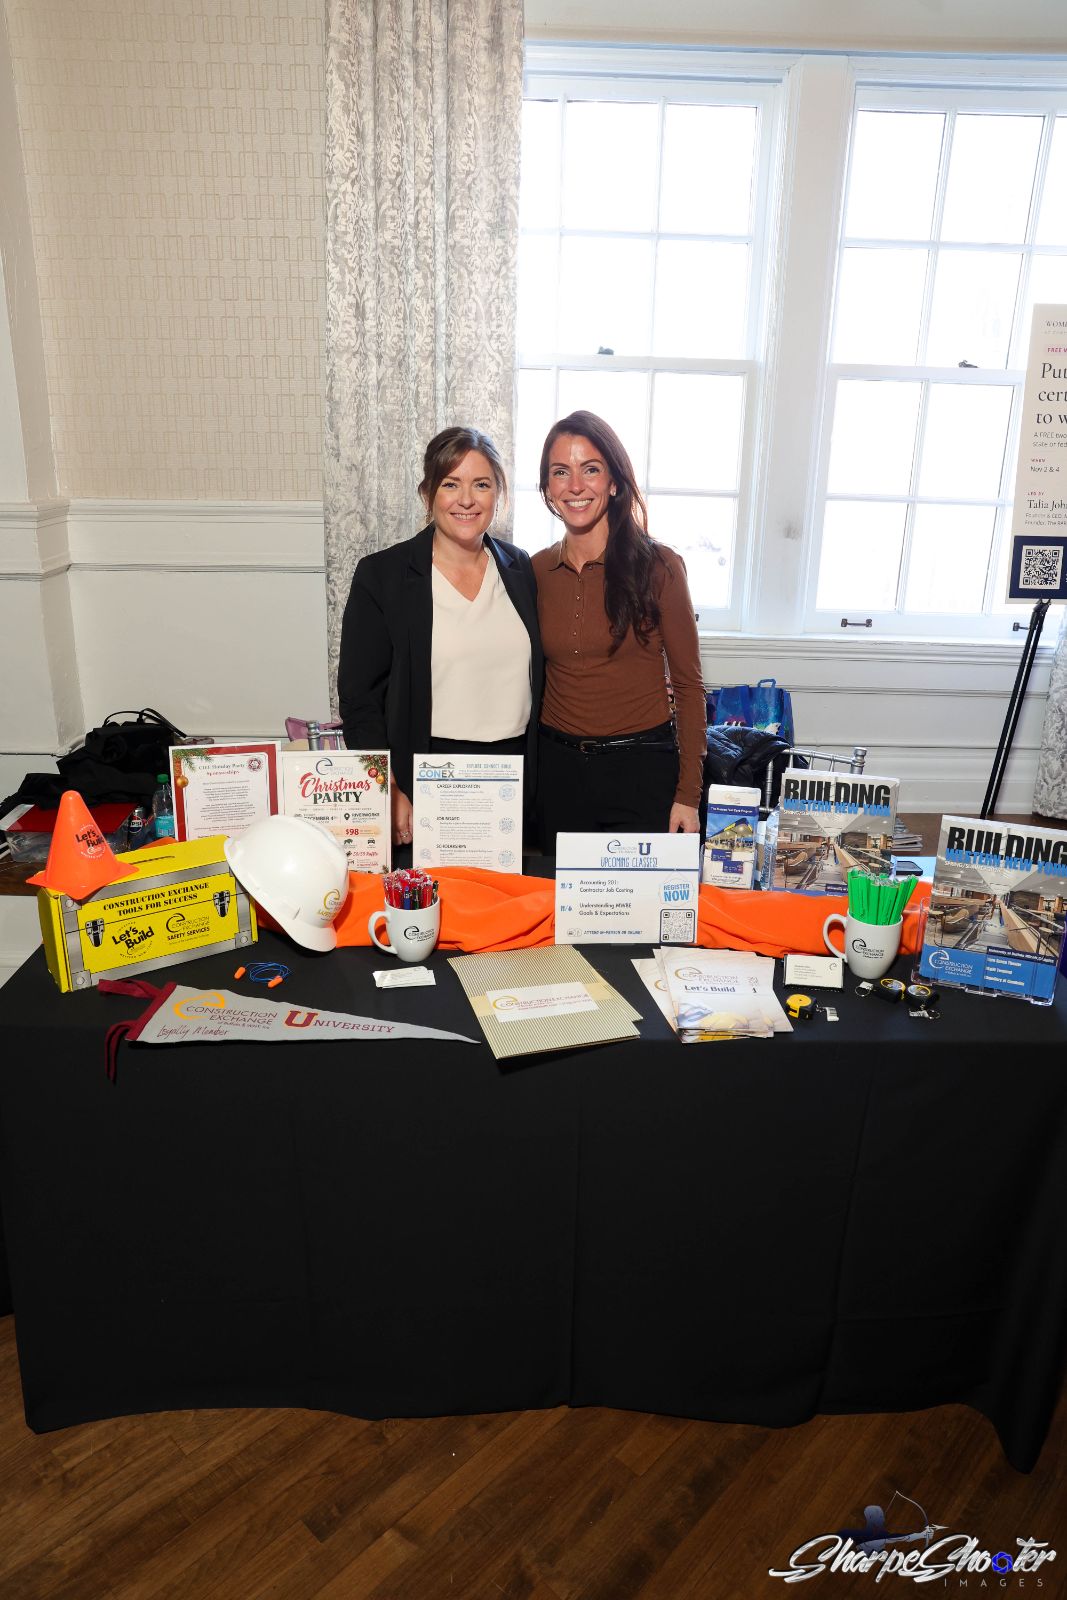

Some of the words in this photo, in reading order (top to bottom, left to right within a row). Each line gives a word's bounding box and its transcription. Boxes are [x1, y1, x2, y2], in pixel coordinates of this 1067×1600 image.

[1036, 413, 1053, 425] to
[1027, 499, 1049, 509] Talia
[418, 769, 455, 779] CONEX
[300, 772, 372, 798] Christmas
[313, 791, 363, 804] PARTY
[784, 778, 891, 808] BUILDING
[783, 796, 831, 813] WESTERN
[835, 801, 859, 814] NEW
[863, 804, 891, 817] YORK
[345, 828, 360, 836] $98
[638, 842, 652, 856] U
[946, 826, 1067, 866] BUILDING
[600, 857, 630, 868] UPCOMING
[944, 847, 1002, 867] WESTERN
[1004, 855, 1033, 872] NEW
[663, 883, 690, 891] REGISTER
[103, 891, 166, 911] CONSTRUCTION
[167, 882, 210, 897] EXCHANGE
[664, 892, 690, 902] NOW
[117, 904, 143, 917] TOOLS
[145, 901, 163, 911] FOR
[163, 892, 199, 907] SUCCESS
[112, 925, 140, 945] Let's
[124, 925, 155, 950] Build
[167, 932, 186, 941] SAFETY
[186, 926, 210, 936] SERVICES
[934, 959, 974, 970] CONSTRUCTION
[944, 966, 973, 975] EXCHANGE
[186, 1005, 278, 1019] CONSTRUCTION
[284, 1010, 396, 1033] UNIVERSITY
[209, 1014, 274, 1026] EXCHANGE
[192, 1026, 230, 1036] Member
